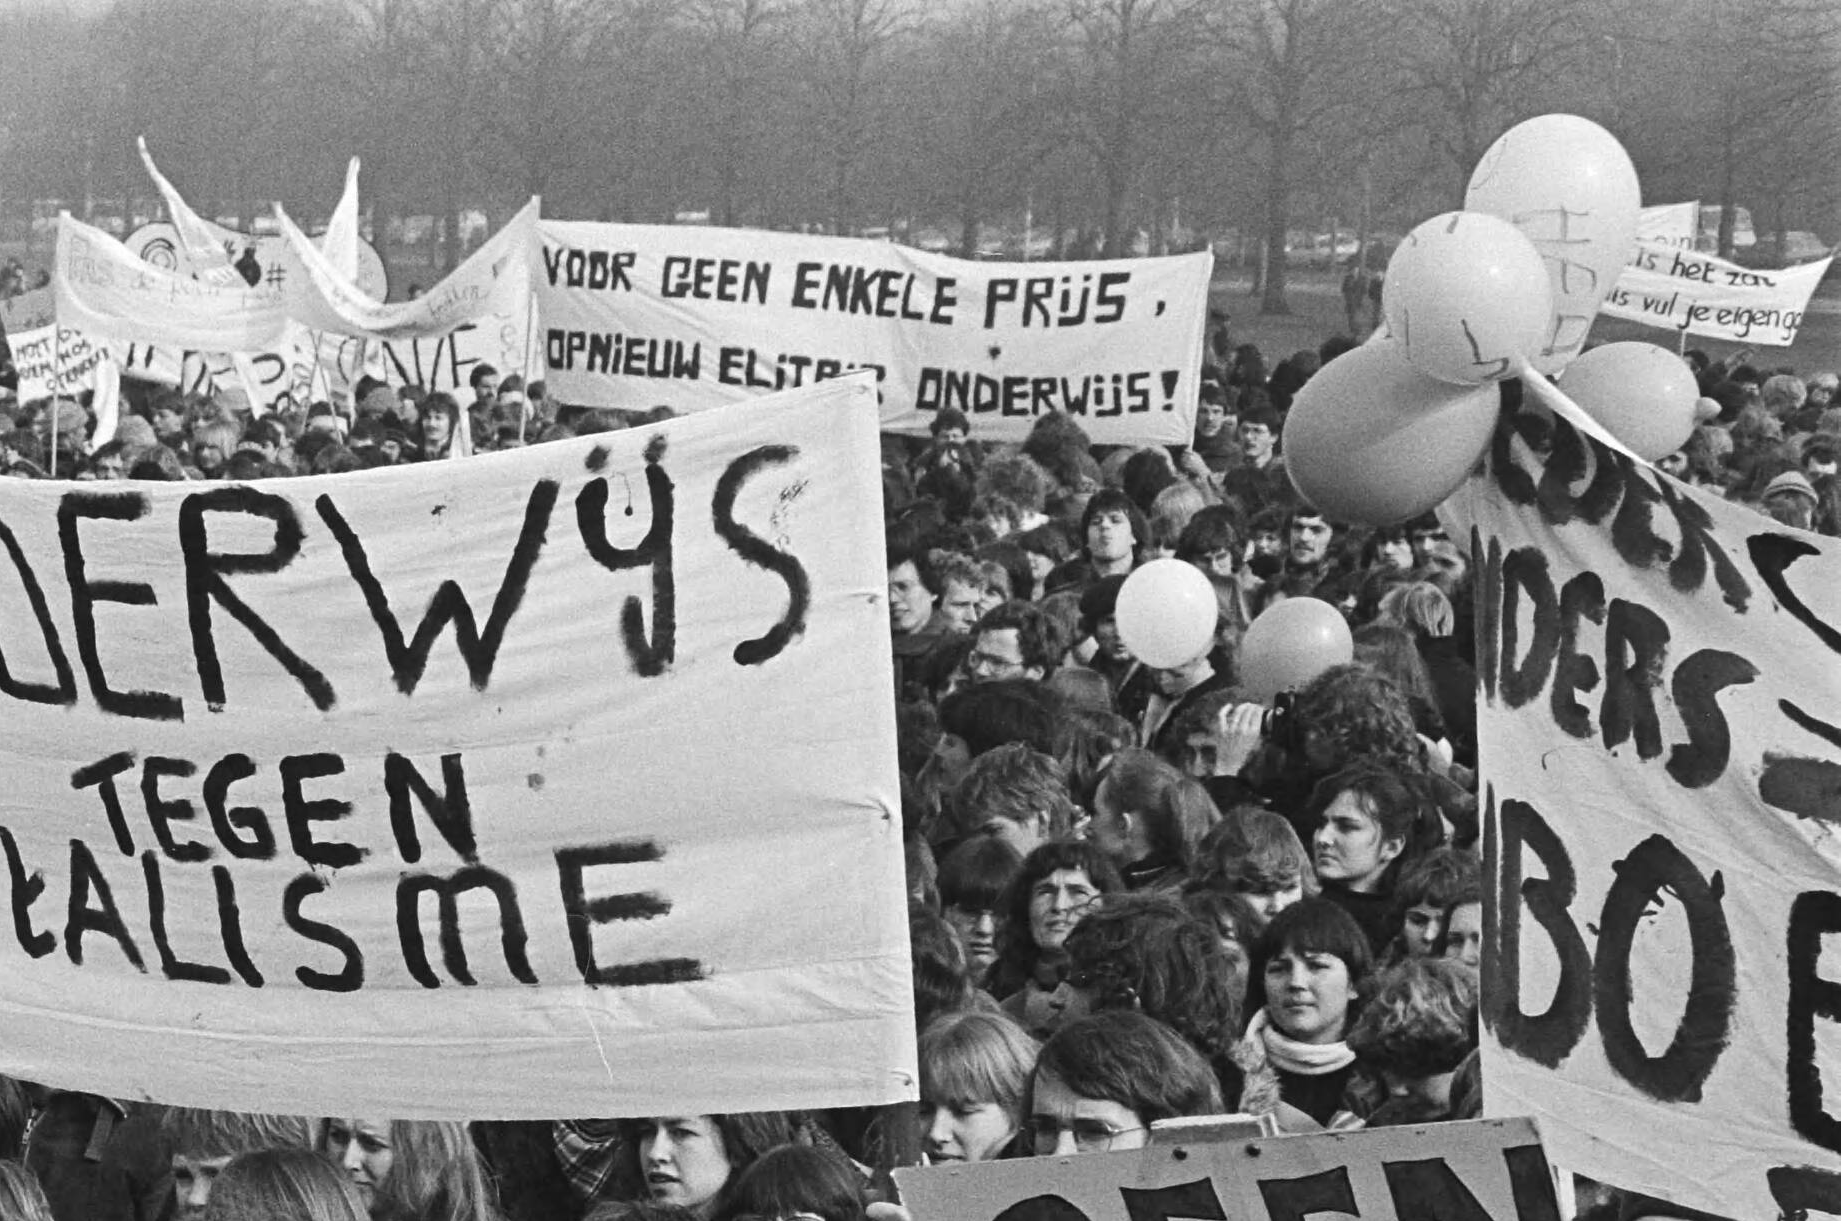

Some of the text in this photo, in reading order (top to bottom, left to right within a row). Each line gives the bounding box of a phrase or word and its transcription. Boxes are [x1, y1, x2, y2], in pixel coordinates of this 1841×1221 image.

[542, 245, 636, 293] VOOR
[661, 256, 771, 304] GEEN
[791, 262, 957, 327] ENKELE
[1671, 252, 1716, 284] het
[1643, 292, 1679, 317] vul
[1677, 300, 1710, 329] je
[1716, 306, 1780, 338] eigen
[73, 751, 480, 867] TEGEN
